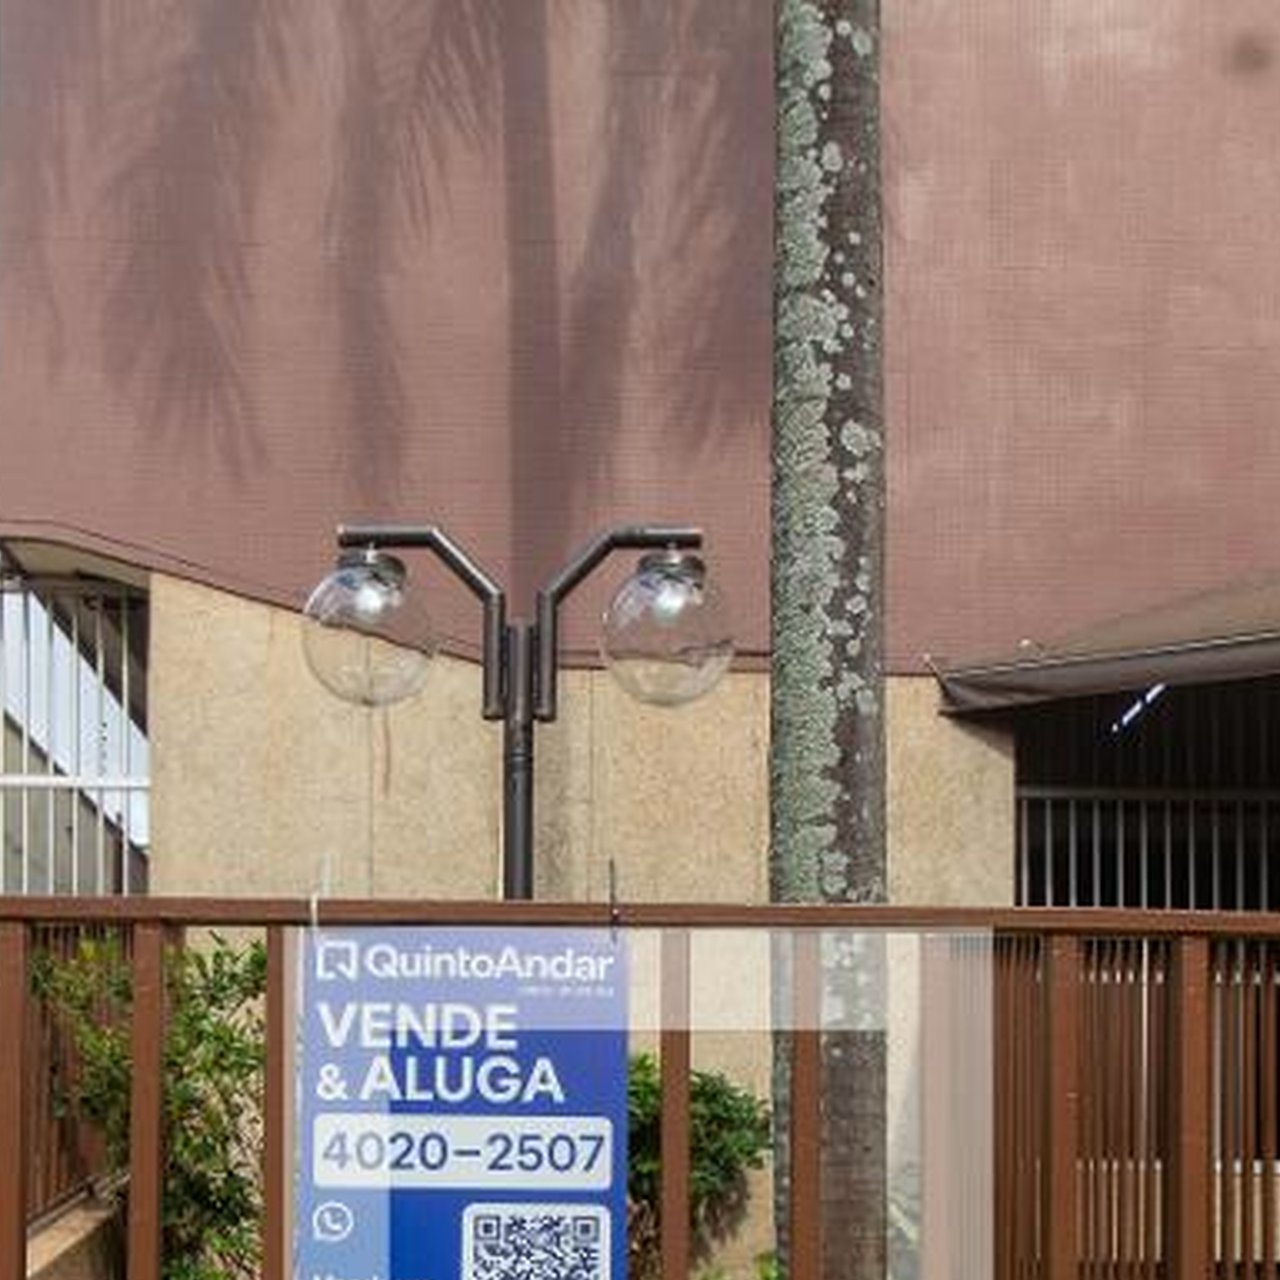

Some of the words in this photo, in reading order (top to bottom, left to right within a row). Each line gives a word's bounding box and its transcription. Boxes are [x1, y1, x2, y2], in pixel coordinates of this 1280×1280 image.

[365, 944, 615, 982] QuintoAndar
[319, 1002, 519, 1049] VENDE
[316, 1063, 349, 1101] &
[360, 1056, 565, 1103] ALUGA
[322, 1132, 605, 1172] 4020-2507
